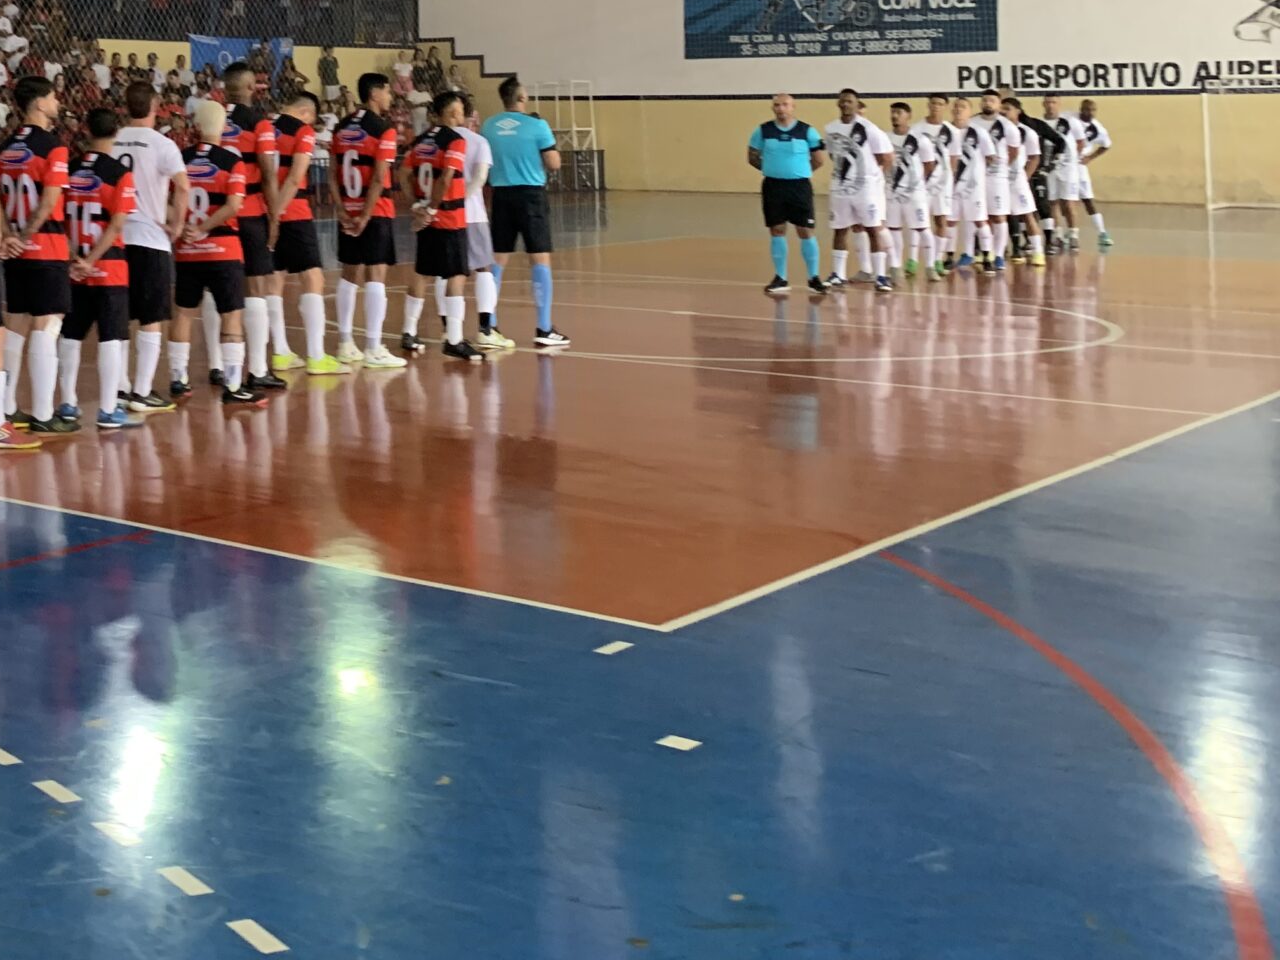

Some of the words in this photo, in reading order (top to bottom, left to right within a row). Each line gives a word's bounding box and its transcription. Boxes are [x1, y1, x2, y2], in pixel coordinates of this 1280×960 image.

[956, 61, 1181, 89] POLIESPORTIVO
[1192, 59, 1280, 87] AURE
[342, 149, 363, 198] 6
[418, 162, 433, 207] 9
[66, 200, 105, 256] 15
